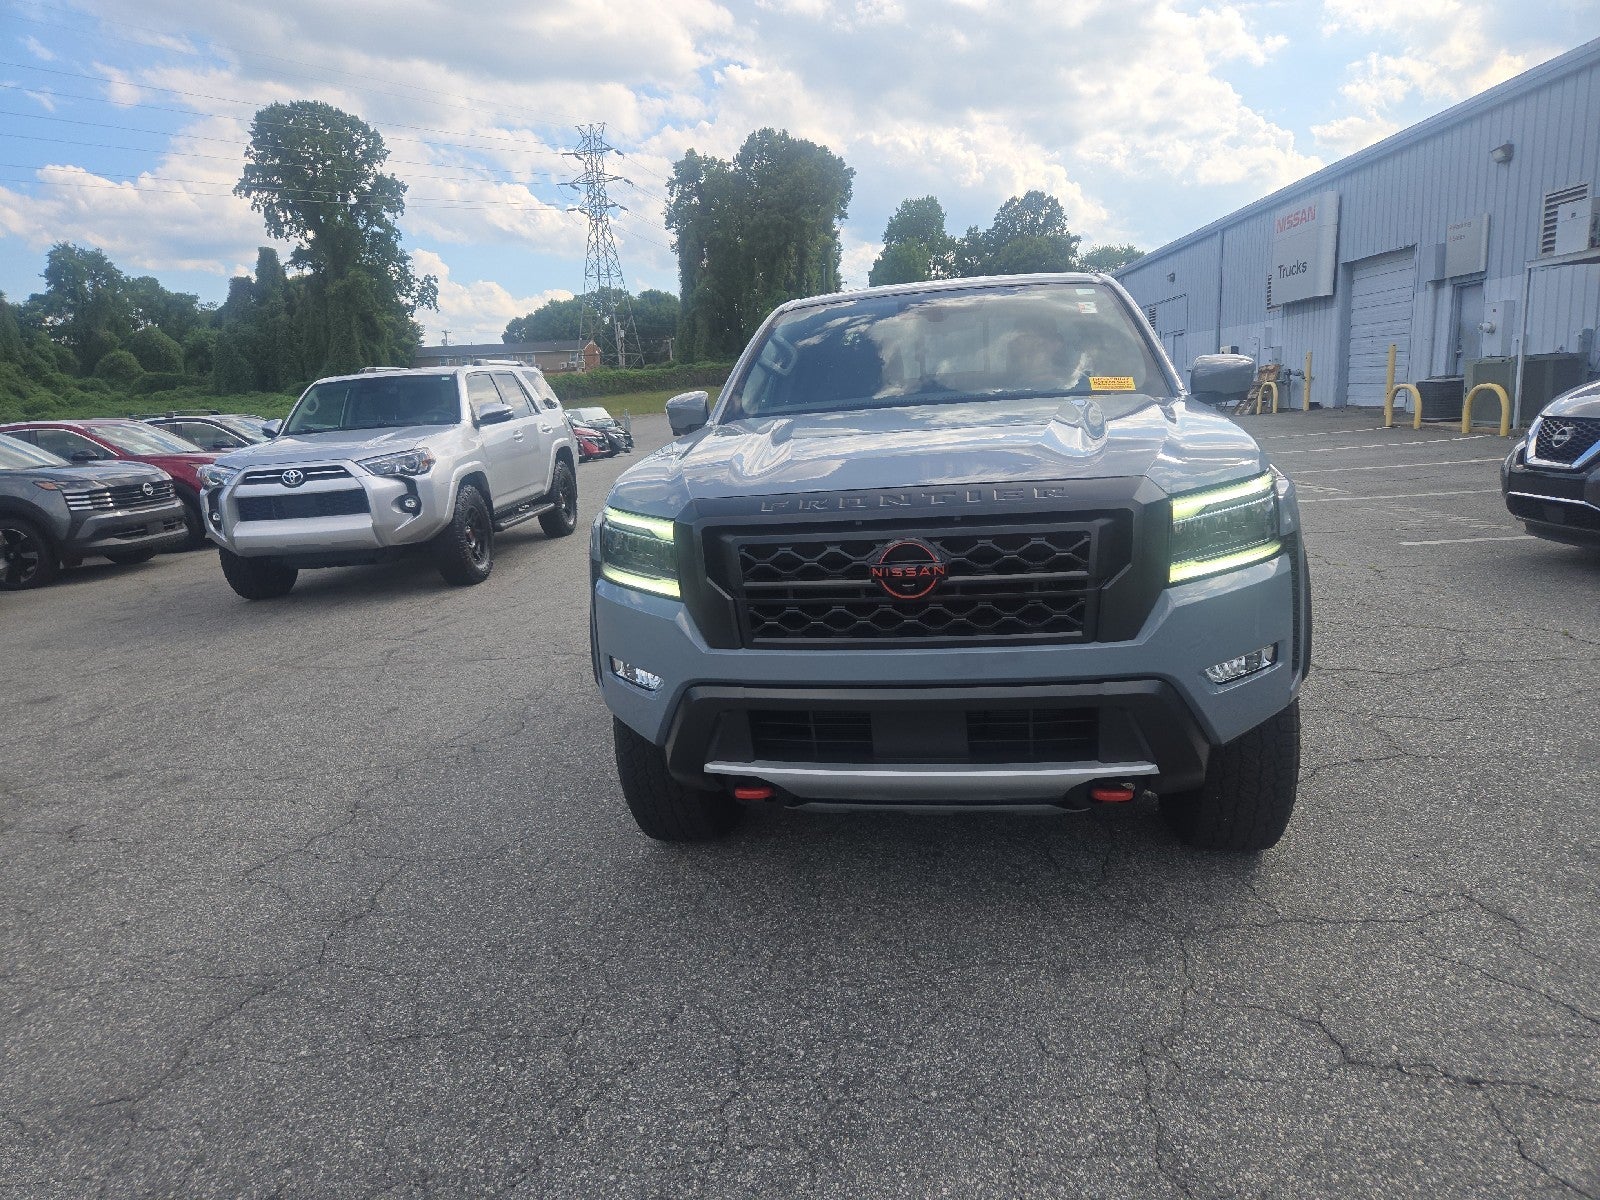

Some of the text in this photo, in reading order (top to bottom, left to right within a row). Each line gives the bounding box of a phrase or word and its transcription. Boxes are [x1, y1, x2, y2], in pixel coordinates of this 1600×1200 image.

[1276, 205, 1317, 233] NISSAN
[1278, 259, 1308, 279] Trucks
[761, 486, 1069, 512] FRONTIER
[871, 563, 946, 578] NISSAN
